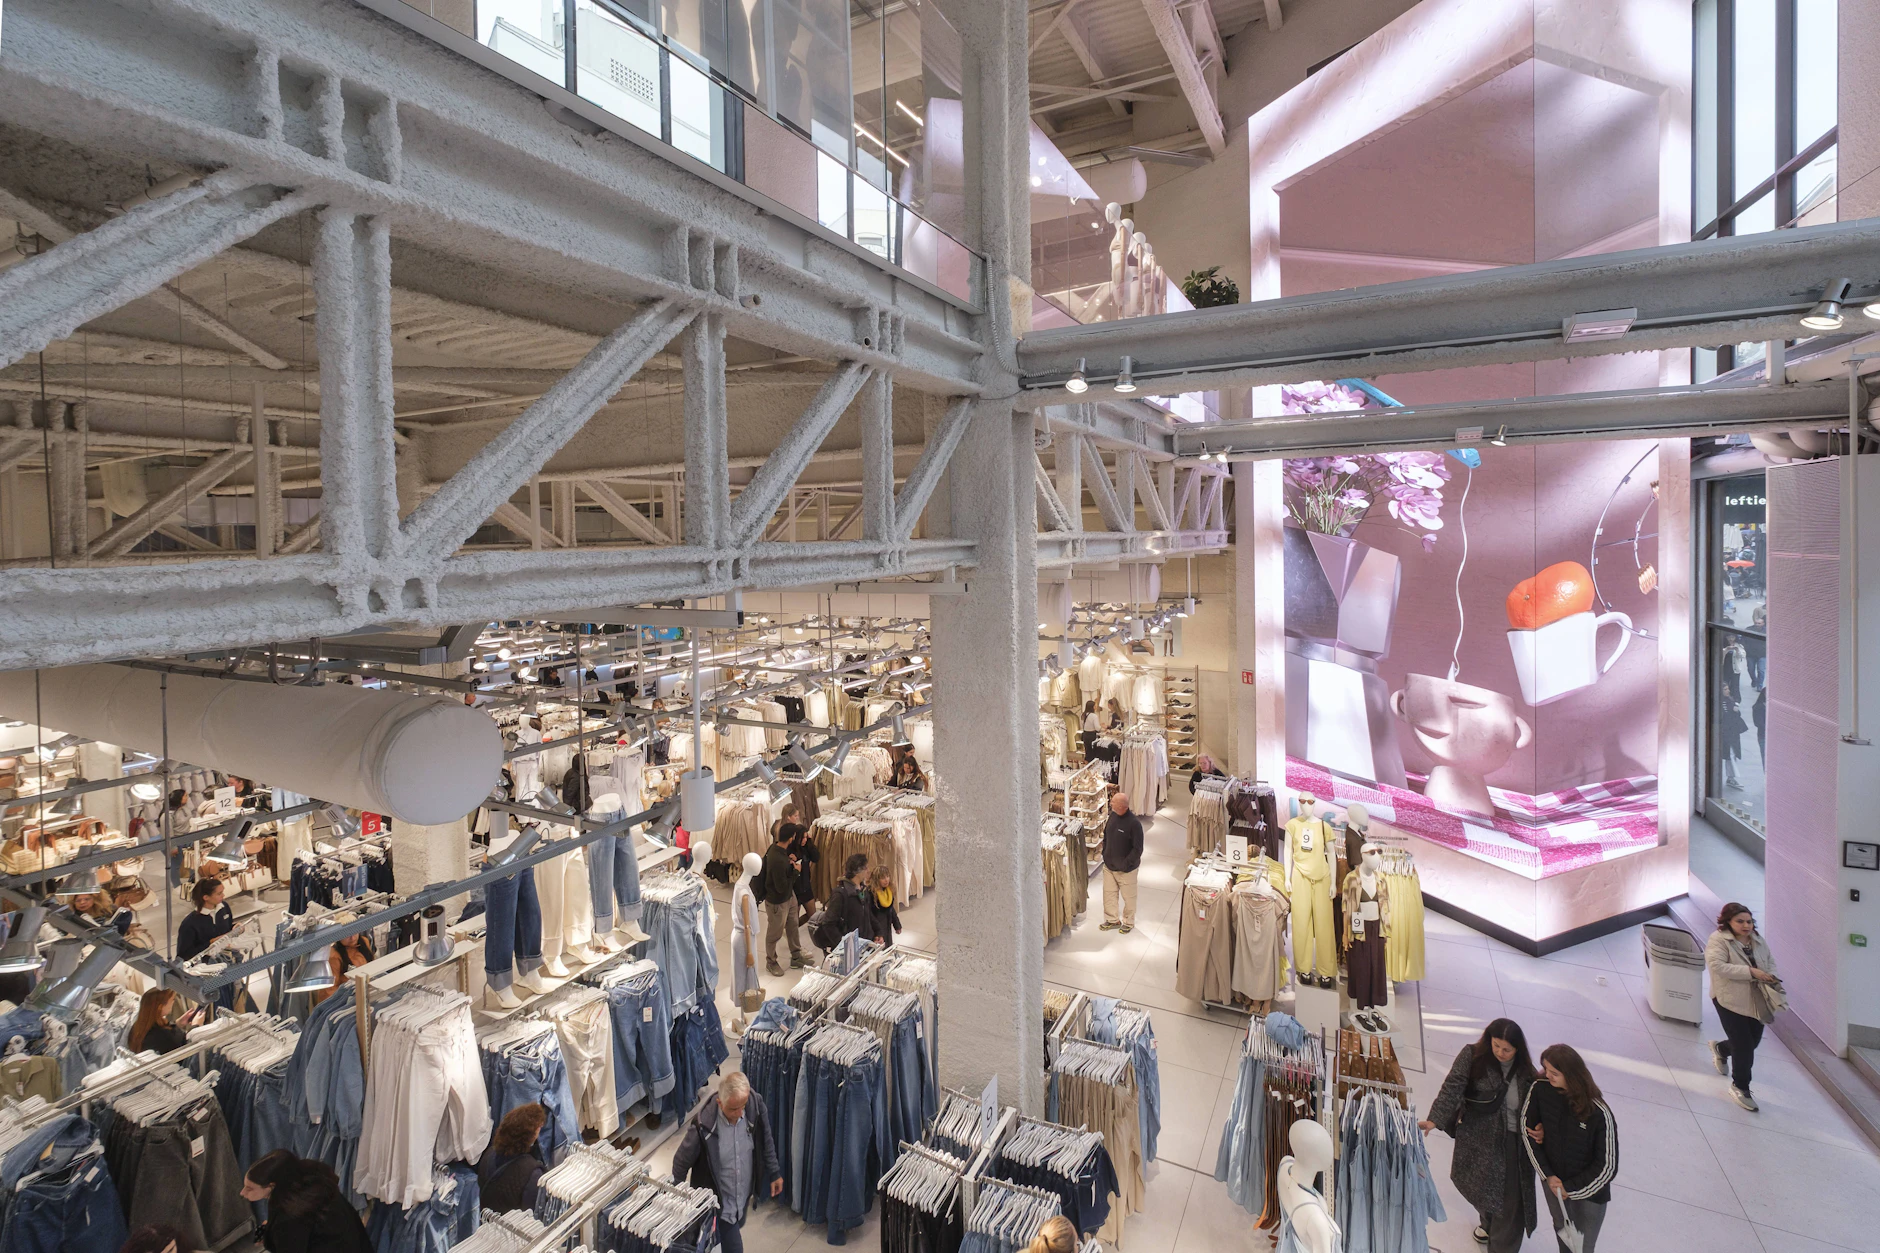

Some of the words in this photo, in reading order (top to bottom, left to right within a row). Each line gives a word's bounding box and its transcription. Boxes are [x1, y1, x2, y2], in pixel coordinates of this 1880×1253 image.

[219, 798, 231, 808] 12
[367, 820, 376, 831] 5
[1303, 834, 1310, 844] 9
[1232, 849, 1241, 861] 8
[1353, 918, 1361, 927] 9
[986, 1106, 993, 1129] 9
